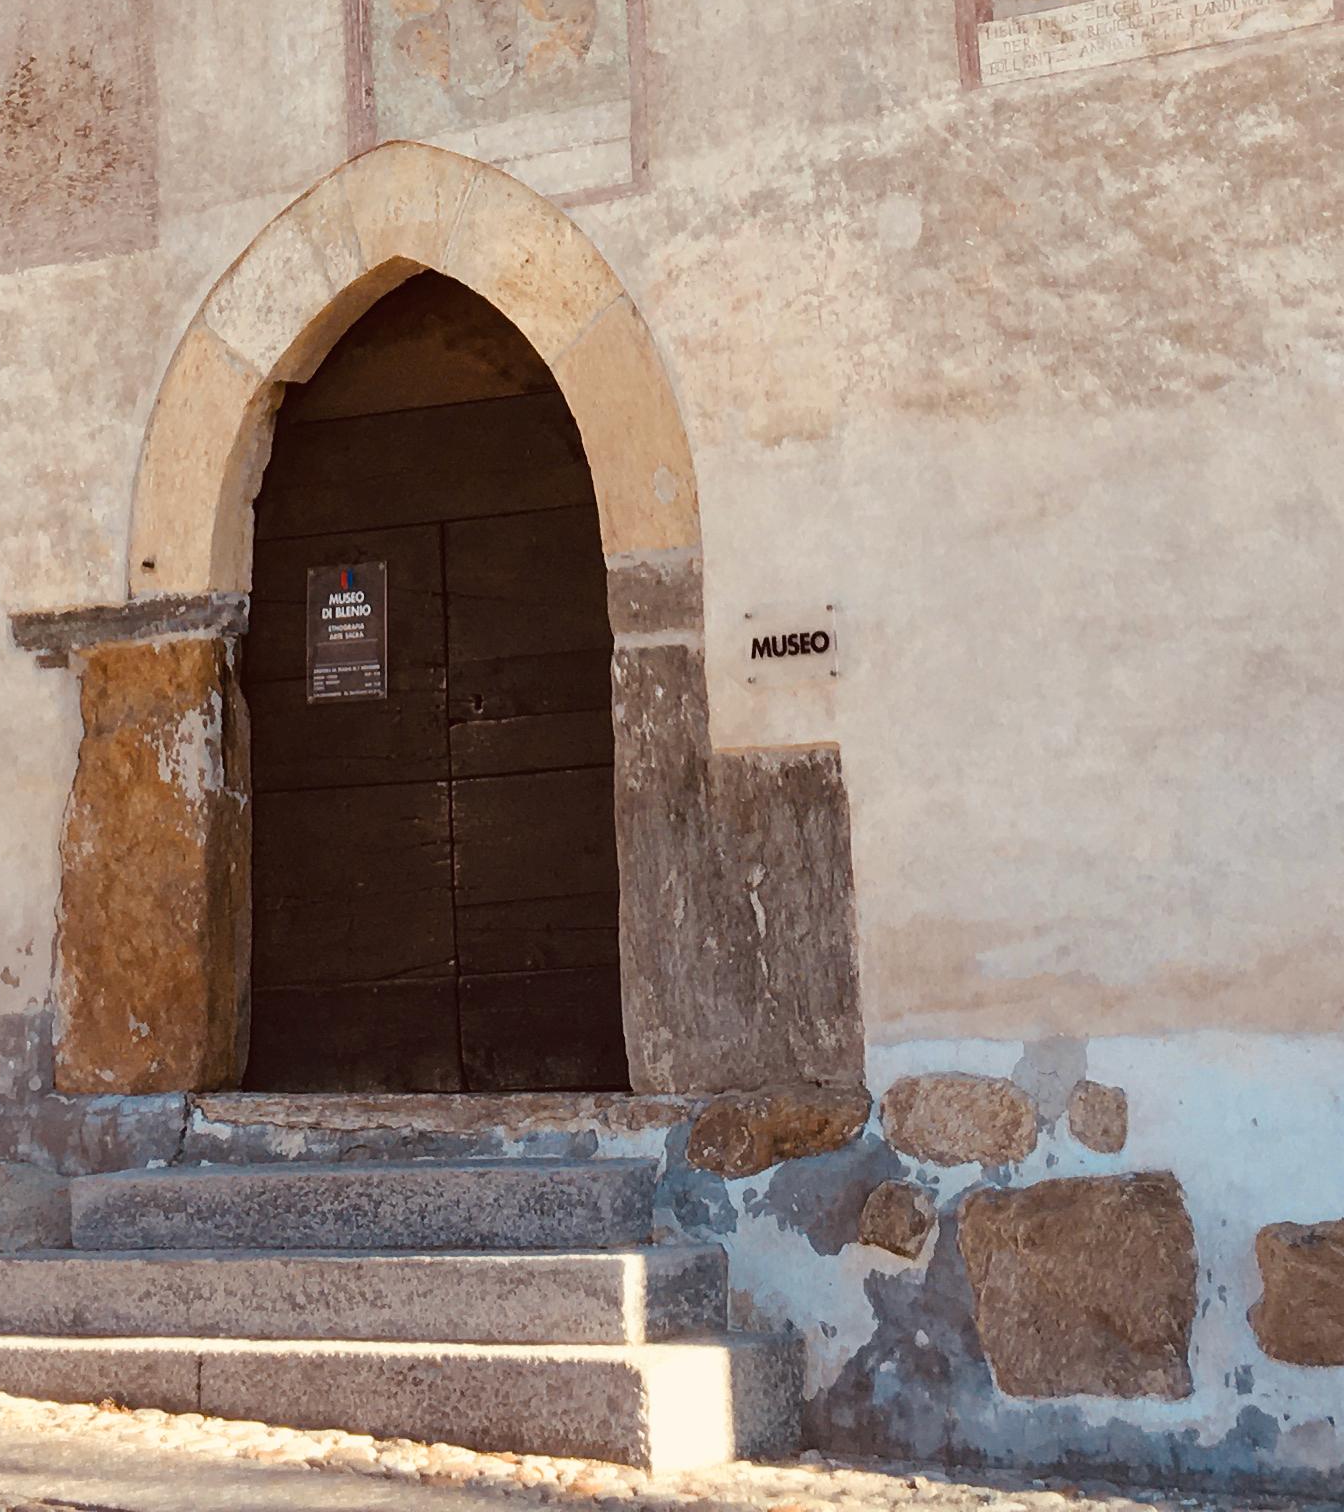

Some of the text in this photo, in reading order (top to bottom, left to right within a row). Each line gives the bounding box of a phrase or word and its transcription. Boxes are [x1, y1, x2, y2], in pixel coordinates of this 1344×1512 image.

[329, 591, 365, 606] MUSEO
[322, 603, 372, 620] DI BLENIO
[751, 631, 830, 659] MUSEO
